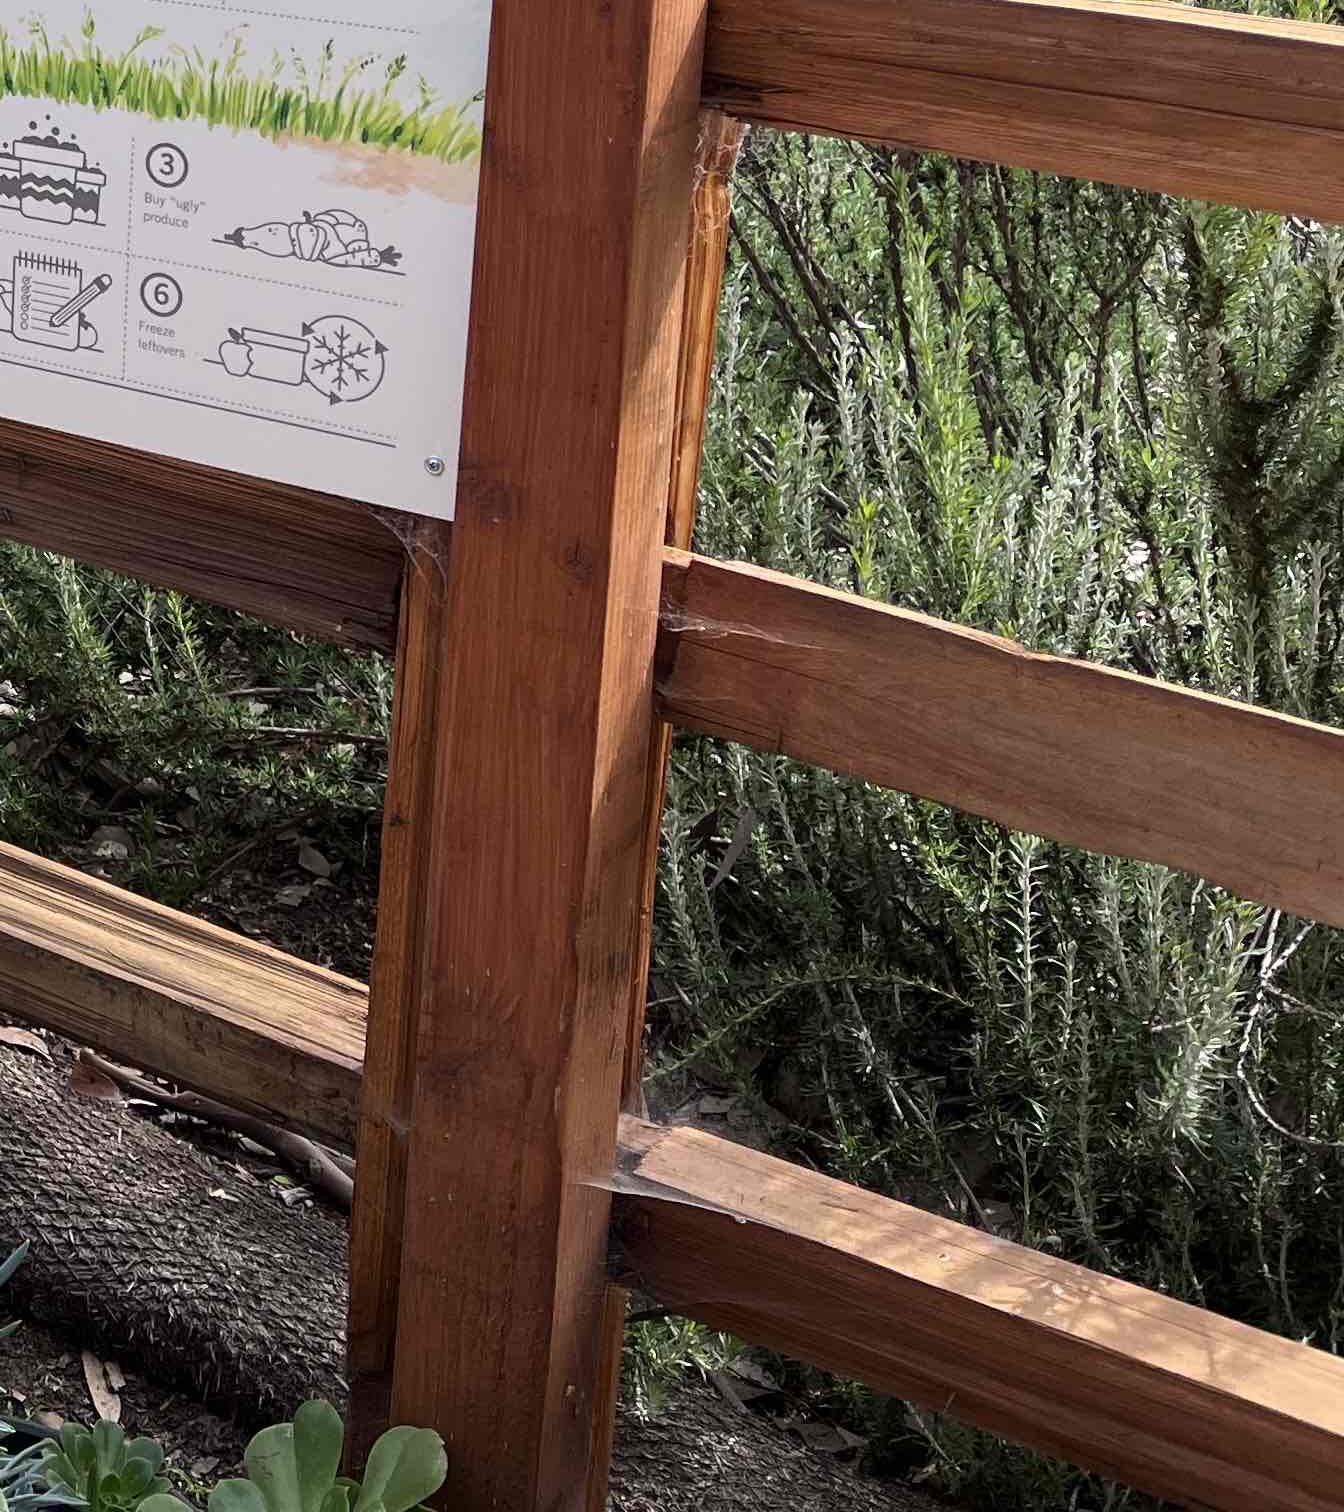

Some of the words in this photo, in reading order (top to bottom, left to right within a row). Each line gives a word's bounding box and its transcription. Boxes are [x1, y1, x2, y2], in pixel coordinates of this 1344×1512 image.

[142, 187, 169, 210] Buy
[168, 195, 207, 216] "ugly"
[142, 211, 190, 230] produce
[137, 318, 177, 339] Freeze
